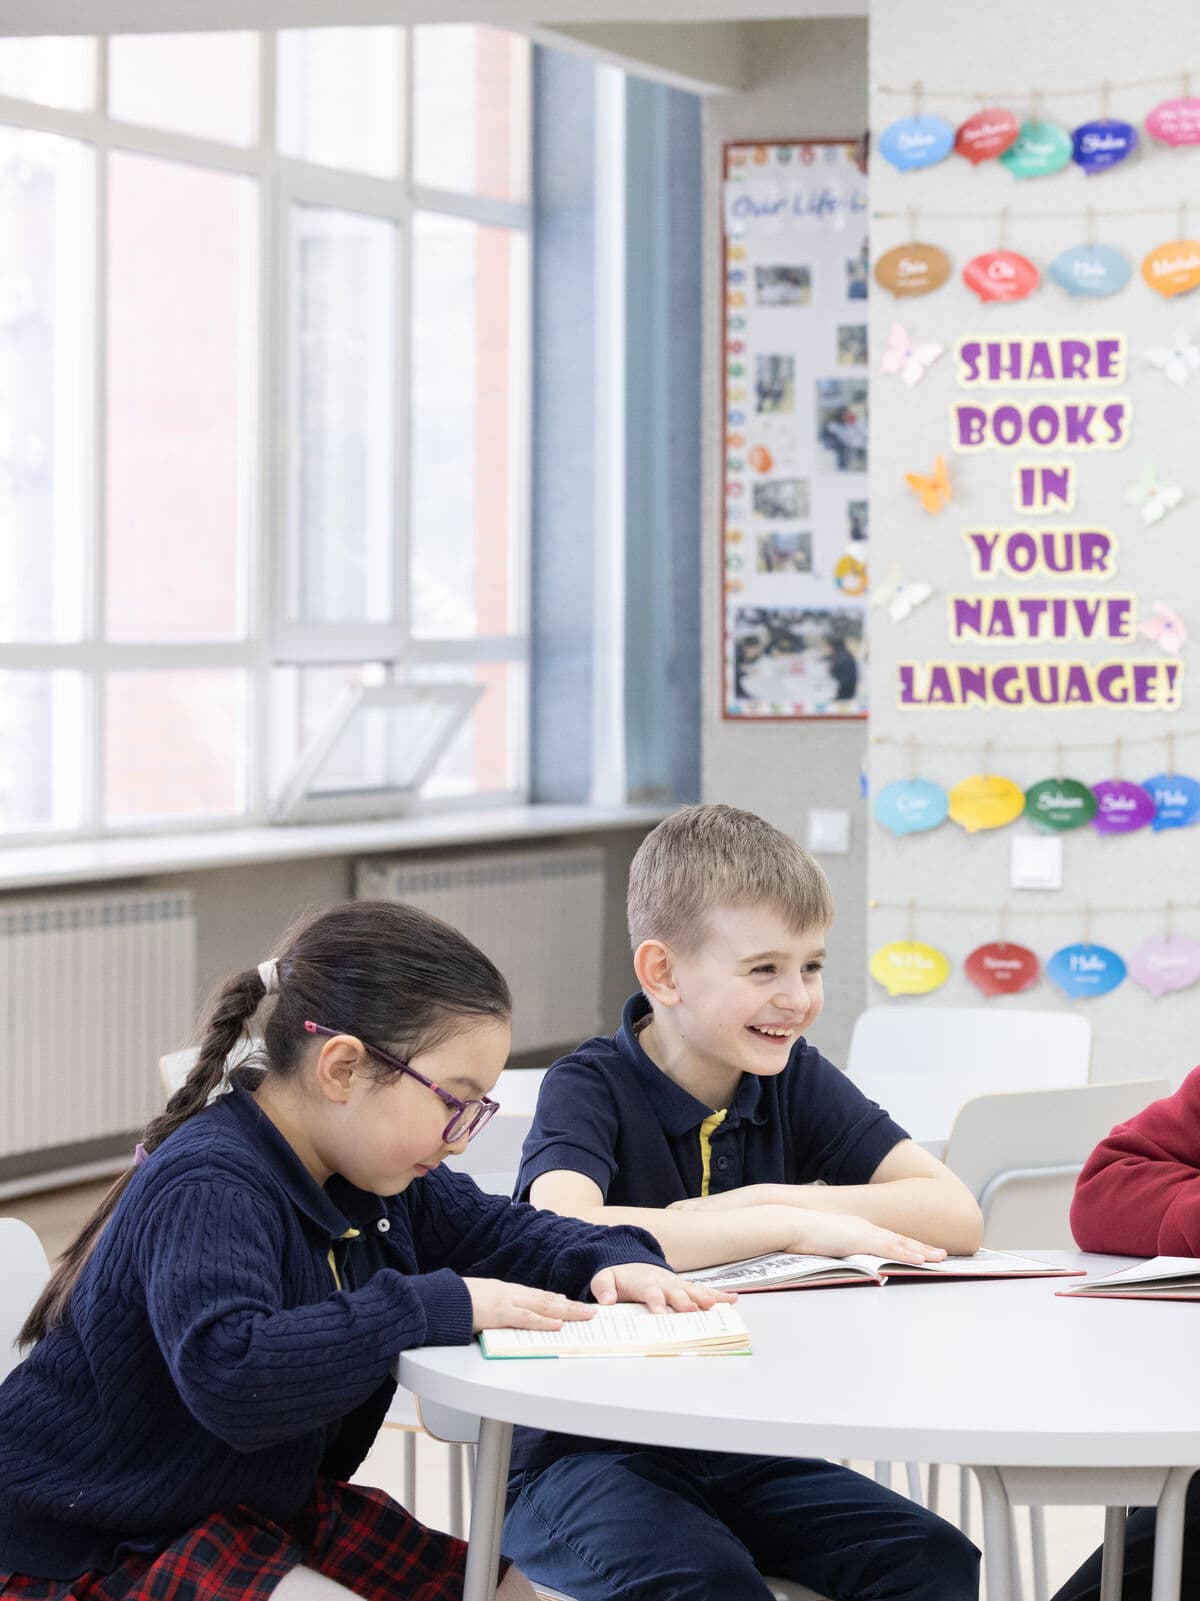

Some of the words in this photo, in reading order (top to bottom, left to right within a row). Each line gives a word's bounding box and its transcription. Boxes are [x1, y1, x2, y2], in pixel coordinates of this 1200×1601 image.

[960, 340, 1120, 381] SHARE
[957, 404, 1124, 445] BOOKS
[1020, 468, 1069, 506] IN
[970, 532, 1111, 573] YOUR
[954, 599, 1132, 638] NATIVE
[900, 664, 1179, 704] LANGUAGE!
